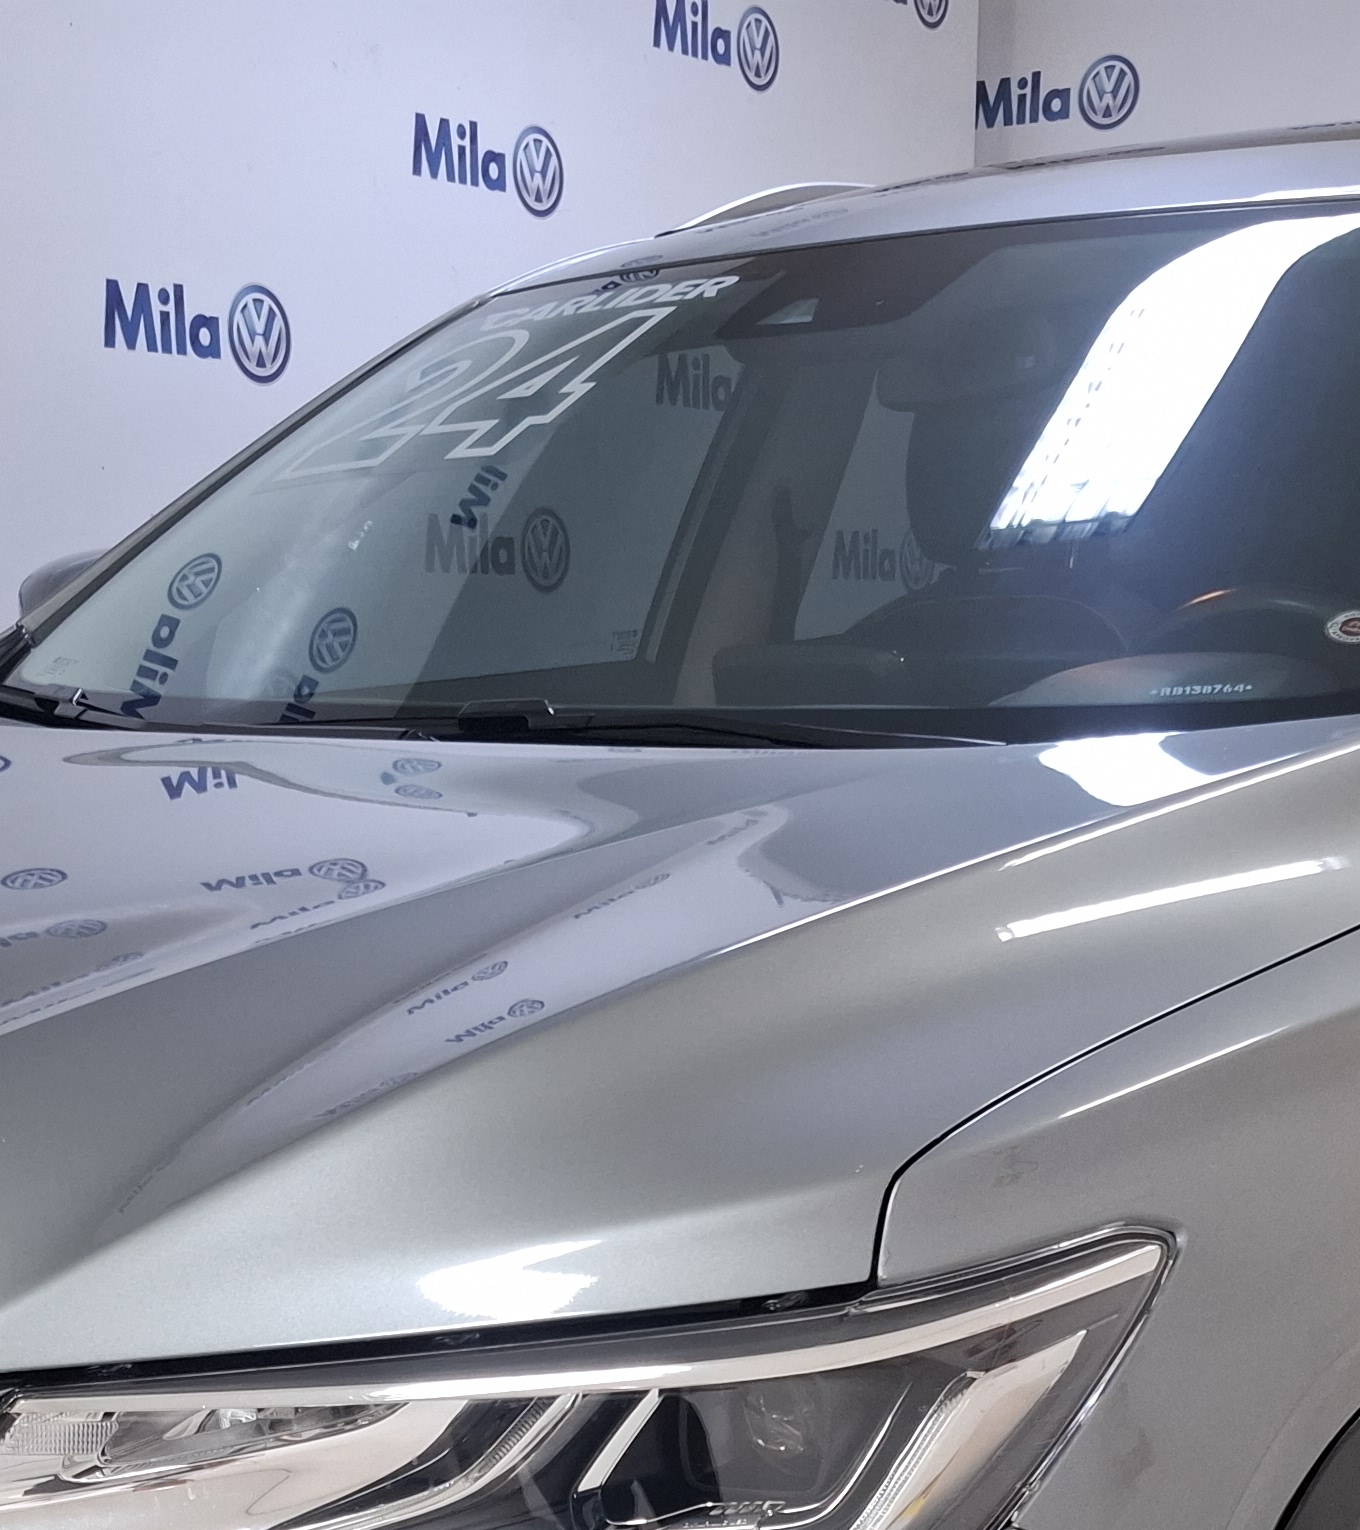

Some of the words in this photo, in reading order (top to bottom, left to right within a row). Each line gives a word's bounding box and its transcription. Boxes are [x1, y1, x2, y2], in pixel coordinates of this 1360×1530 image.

[653, 0, 731, 67] Mila
[977, 71, 1071, 129] Mila
[412, 112, 506, 192] Mila
[104, 278, 221, 359] Mila
[481, 276, 739, 331] CARLIDER
[273, 306, 677, 482] 24
